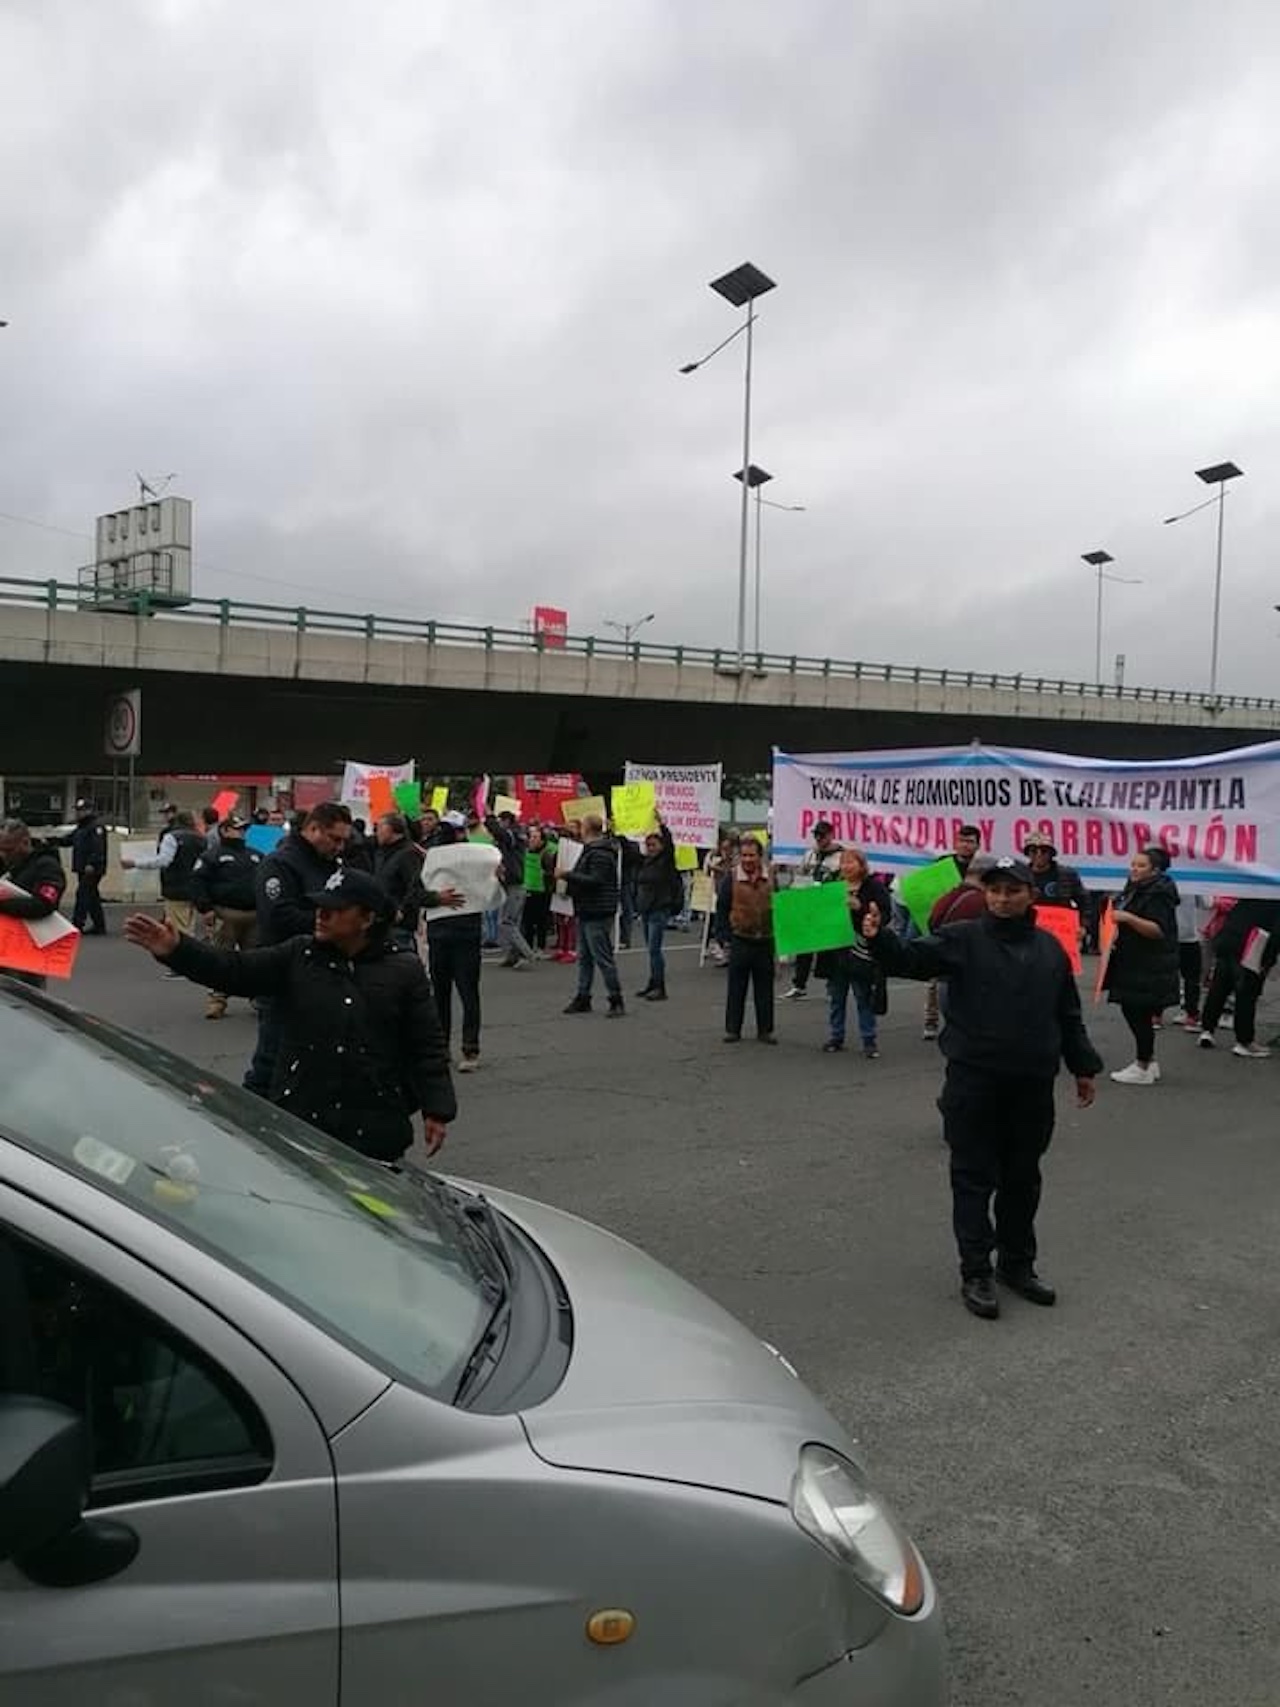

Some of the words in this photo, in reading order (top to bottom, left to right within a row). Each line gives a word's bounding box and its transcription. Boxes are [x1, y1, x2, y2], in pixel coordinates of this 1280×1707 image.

[810, 774, 877, 804] FISCALÍA
[881, 777, 901, 804] DE
[905, 778, 1011, 806] HOMICIDIOS
[1019, 778, 1047, 807] DE
[1052, 777, 1245, 811] TLALNEPANTLA
[979, 819, 995, 852] Y
